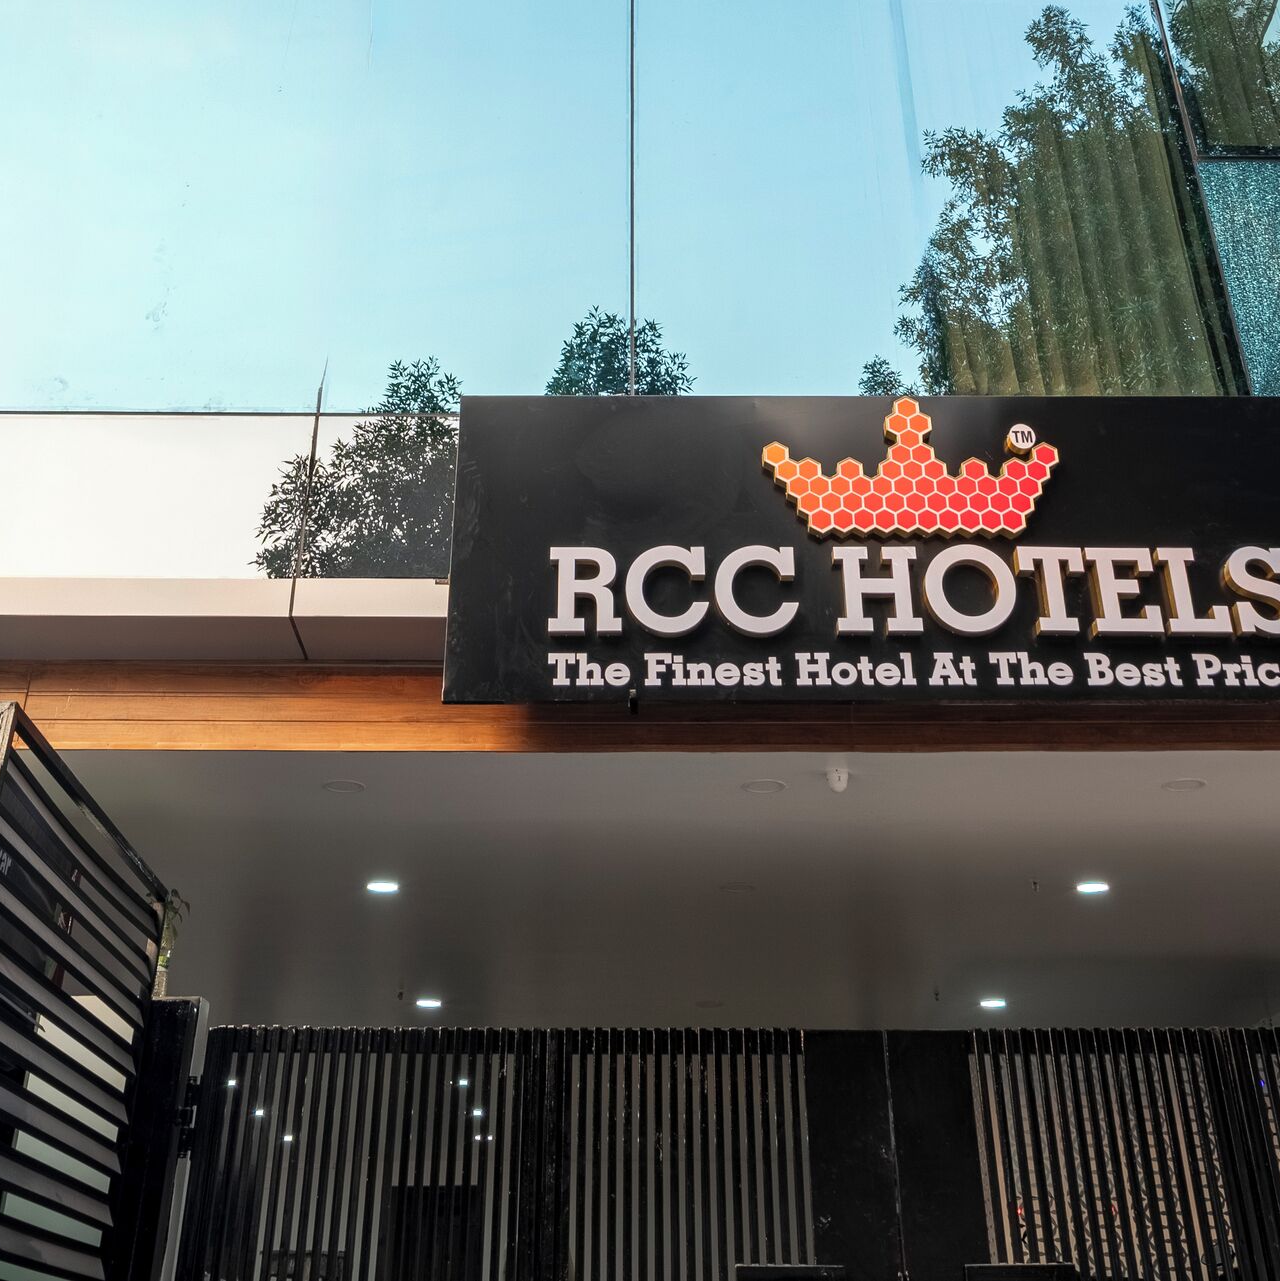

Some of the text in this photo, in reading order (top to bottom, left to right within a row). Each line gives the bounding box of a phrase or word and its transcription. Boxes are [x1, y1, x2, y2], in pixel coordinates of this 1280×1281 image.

[1011, 430, 1034, 444] TM
[547, 544, 801, 637] RCC
[547, 652, 631, 686] The
[643, 652, 783, 687] Finest
[794, 652, 918, 686] Hotel
[928, 651, 978, 686] At
[988, 651, 1074, 686] The
[1083, 652, 1184, 687] Best
